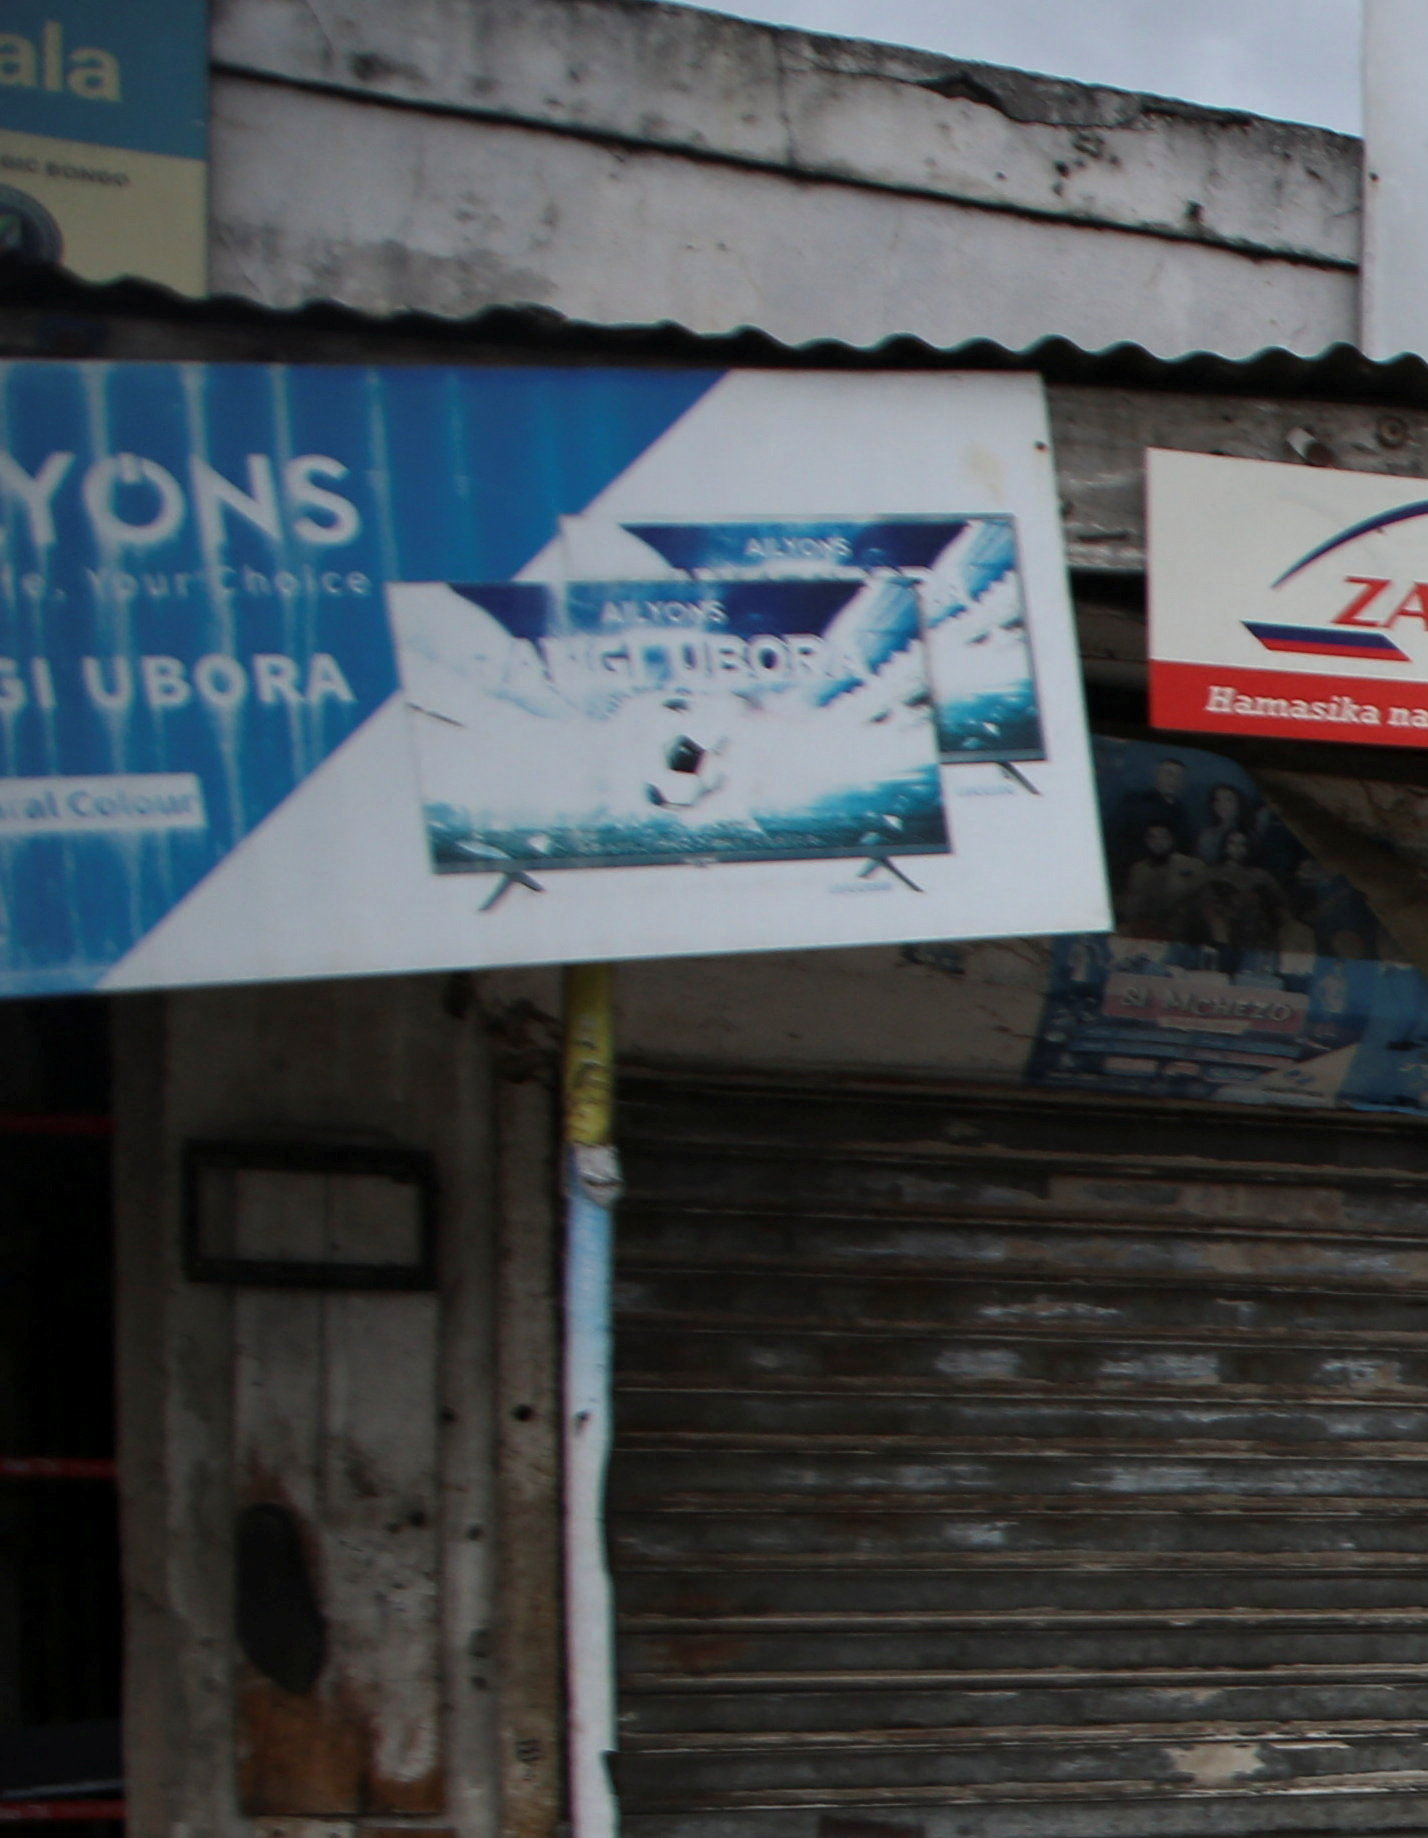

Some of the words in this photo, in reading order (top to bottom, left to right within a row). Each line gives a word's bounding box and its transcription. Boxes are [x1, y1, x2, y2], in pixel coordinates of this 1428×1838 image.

[212, 563, 373, 597] Choice
[82, 653, 359, 707] UBORA
[1204, 685, 1379, 725] Hamasika
